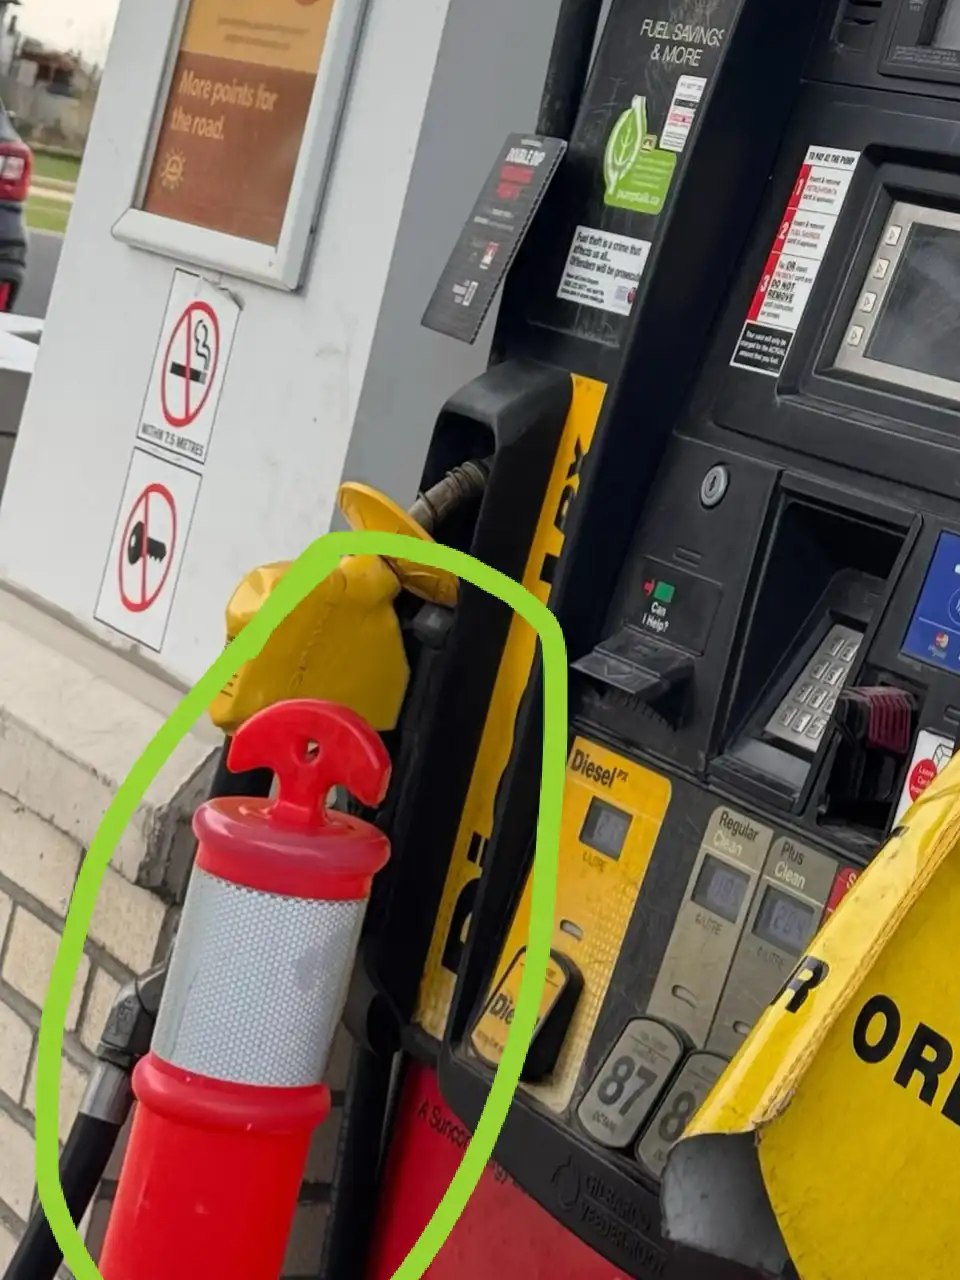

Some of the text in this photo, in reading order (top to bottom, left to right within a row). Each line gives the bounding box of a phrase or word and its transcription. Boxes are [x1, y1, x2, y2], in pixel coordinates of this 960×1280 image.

[640, 19, 669, 39] FUEL
[651, 43, 702, 66] & MORE
[178, 69, 278, 111] More points for
[171, 106, 225, 139] the road.
[793, 178, 804, 195] 1
[778, 221, 789, 240] 2
[760, 274, 770, 293] 3
[770, 279, 796, 292] DO NOT
[767, 289, 794, 303] REMOVE
[177, 435, 205, 457] METRES
[651, 601, 666, 617] Can
[646, 614, 669, 632] Help?
[570, 748, 617, 788] Diesel
[719, 810, 759, 841] Regular
[713, 830, 743, 856] Clean
[781, 841, 805, 865] Plus
[774, 861, 806, 889] Clean
[598, 1055, 658, 1117] 87
